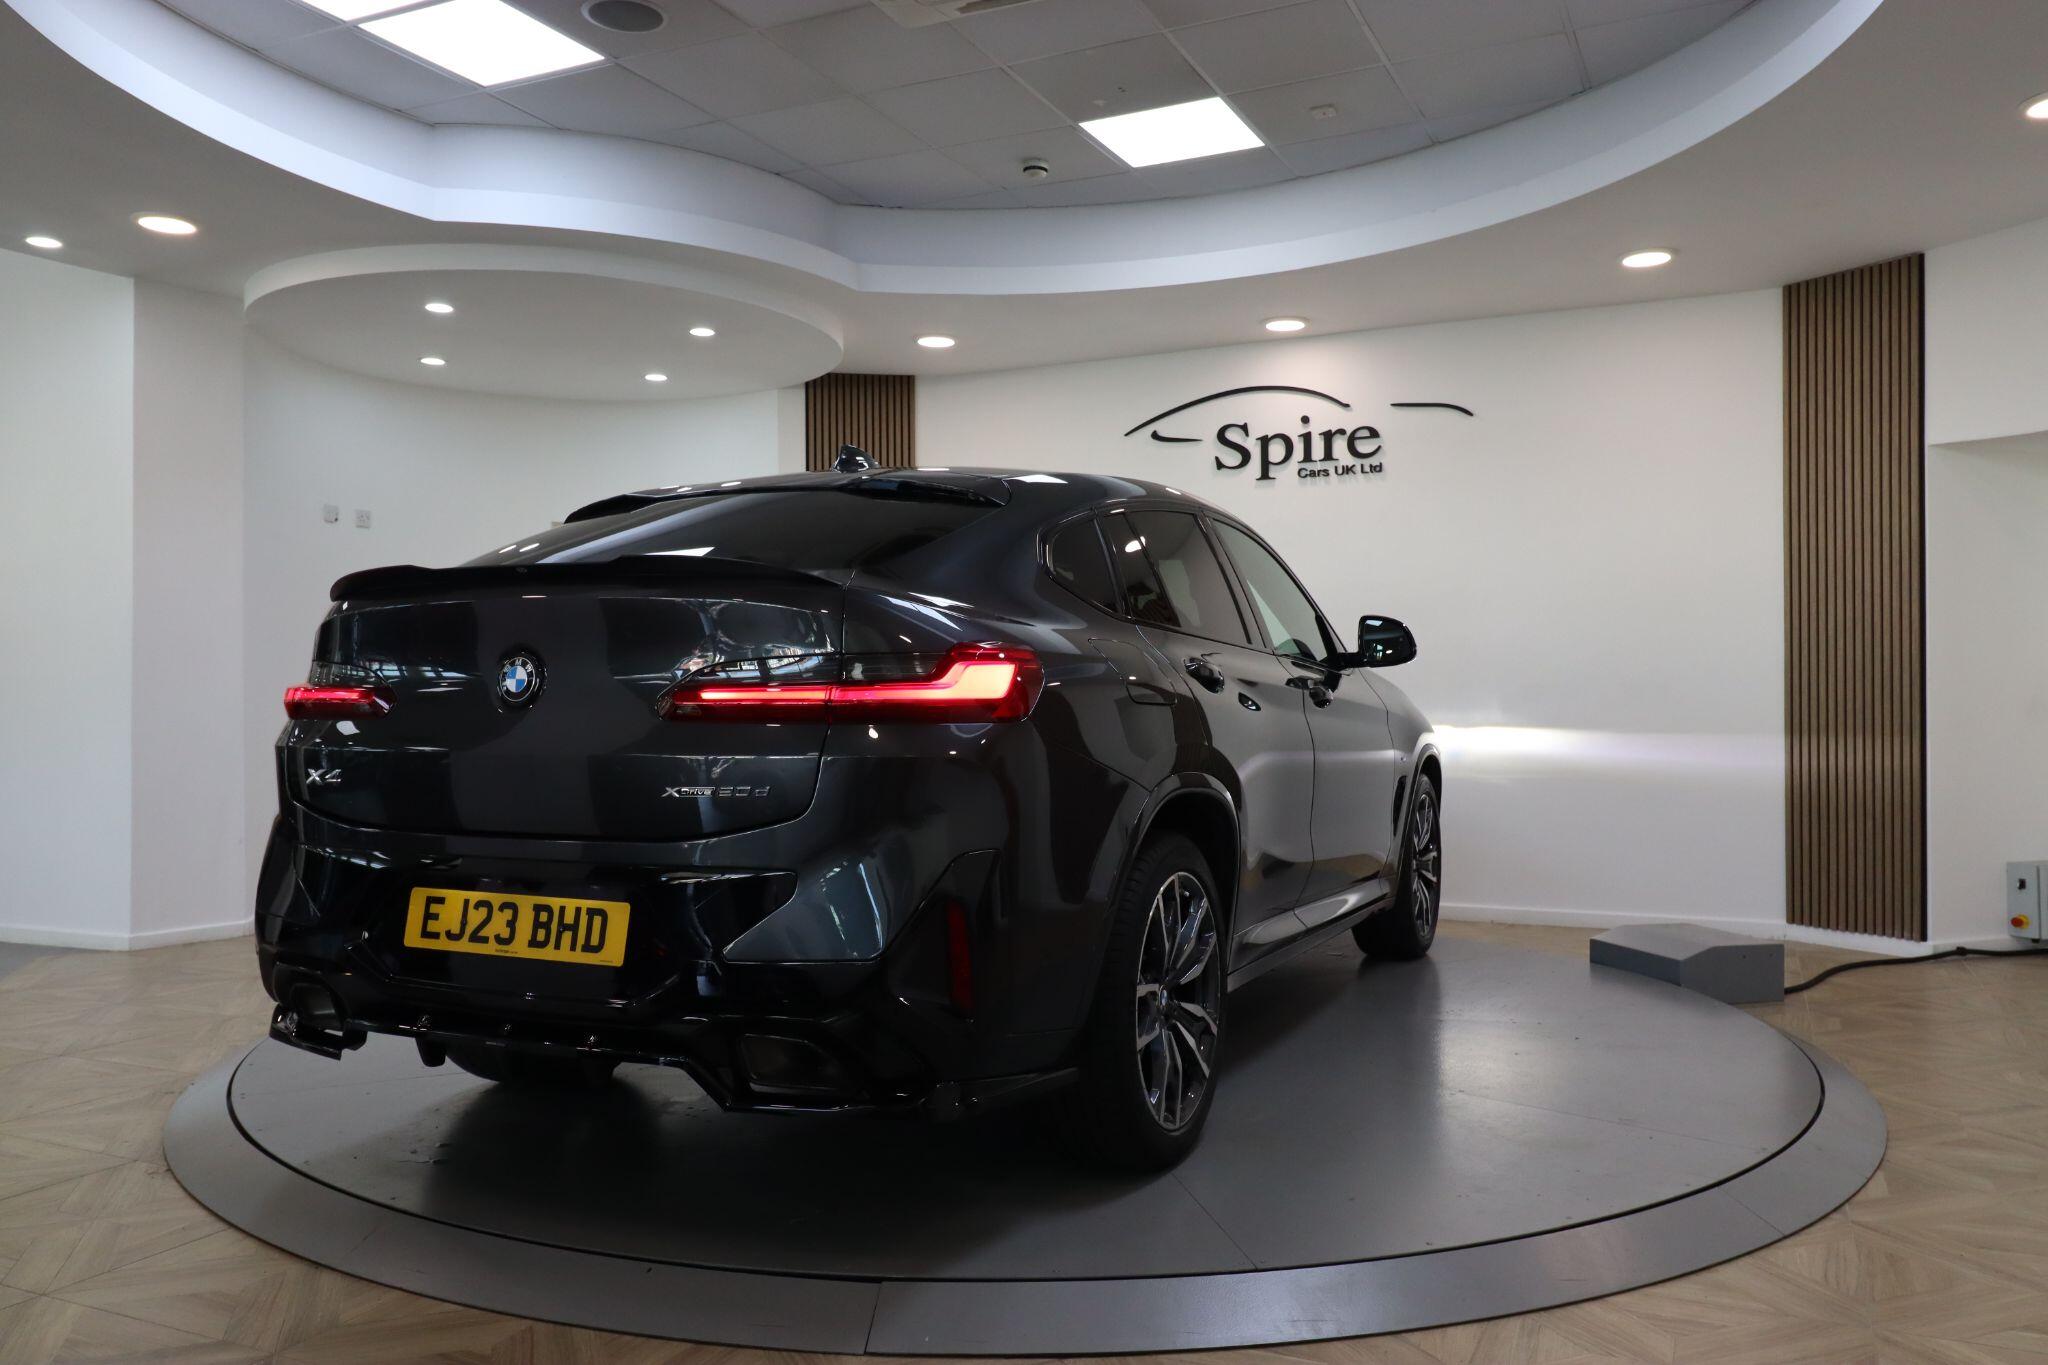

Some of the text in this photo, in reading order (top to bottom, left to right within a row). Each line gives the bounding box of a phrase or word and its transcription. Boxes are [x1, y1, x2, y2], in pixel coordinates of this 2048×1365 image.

[1215, 415, 1382, 481] Spire
[1297, 462, 1383, 479] Cars UK Ltd
[305, 768, 342, 785] X4
[420, 895, 609, 954] EJ23 BHD
